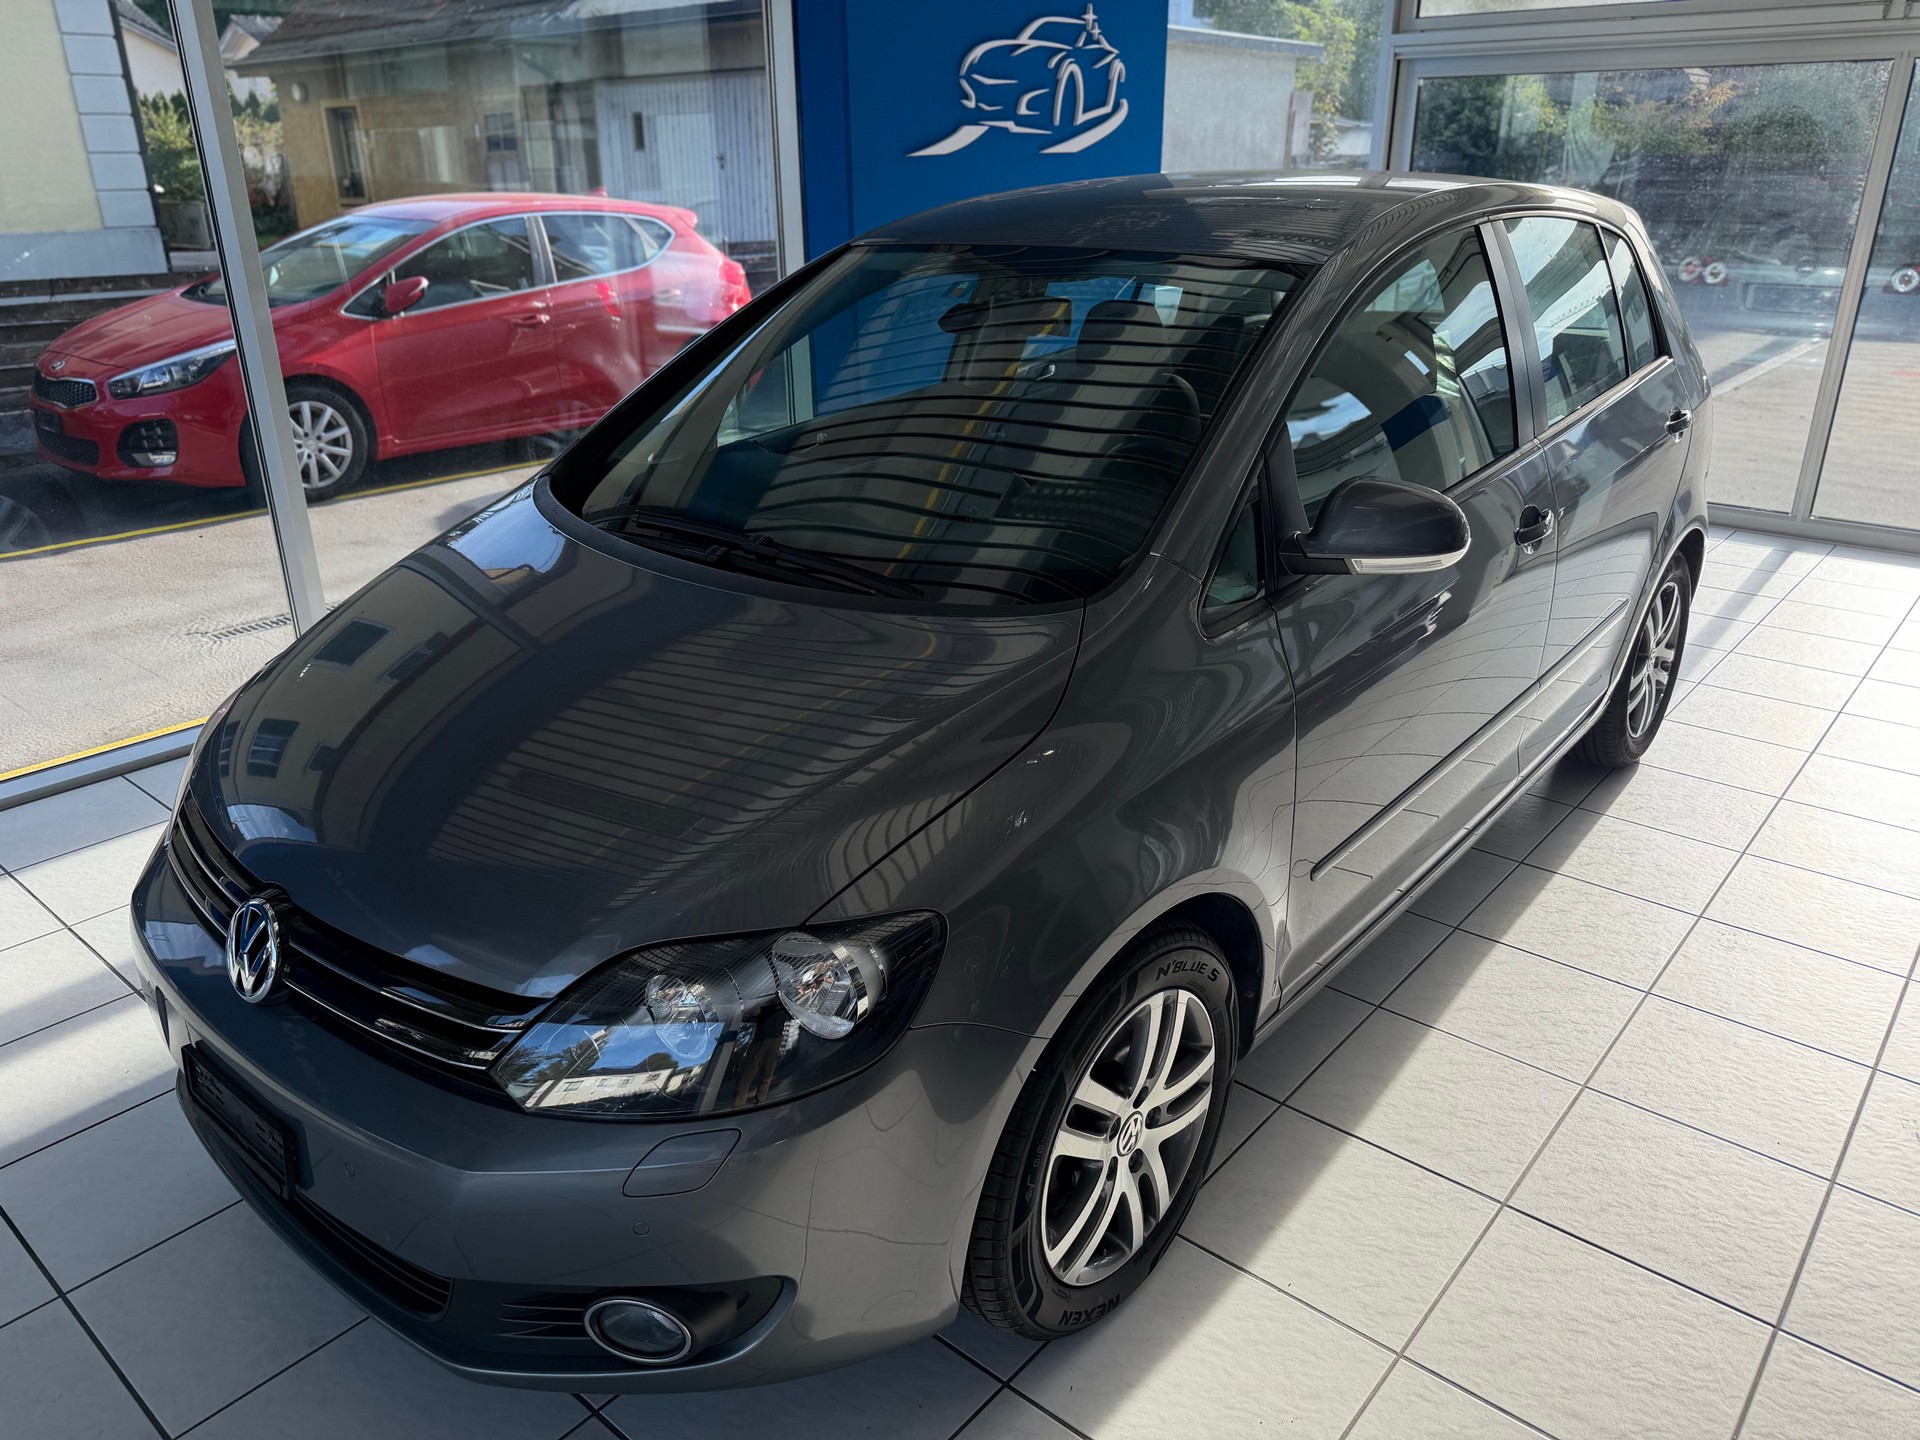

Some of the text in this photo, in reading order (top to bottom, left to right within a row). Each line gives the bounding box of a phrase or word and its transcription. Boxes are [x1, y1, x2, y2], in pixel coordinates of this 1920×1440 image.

[1155, 959, 1220, 982] N'BLUE S
[1057, 1292, 1121, 1326] NEXEN
